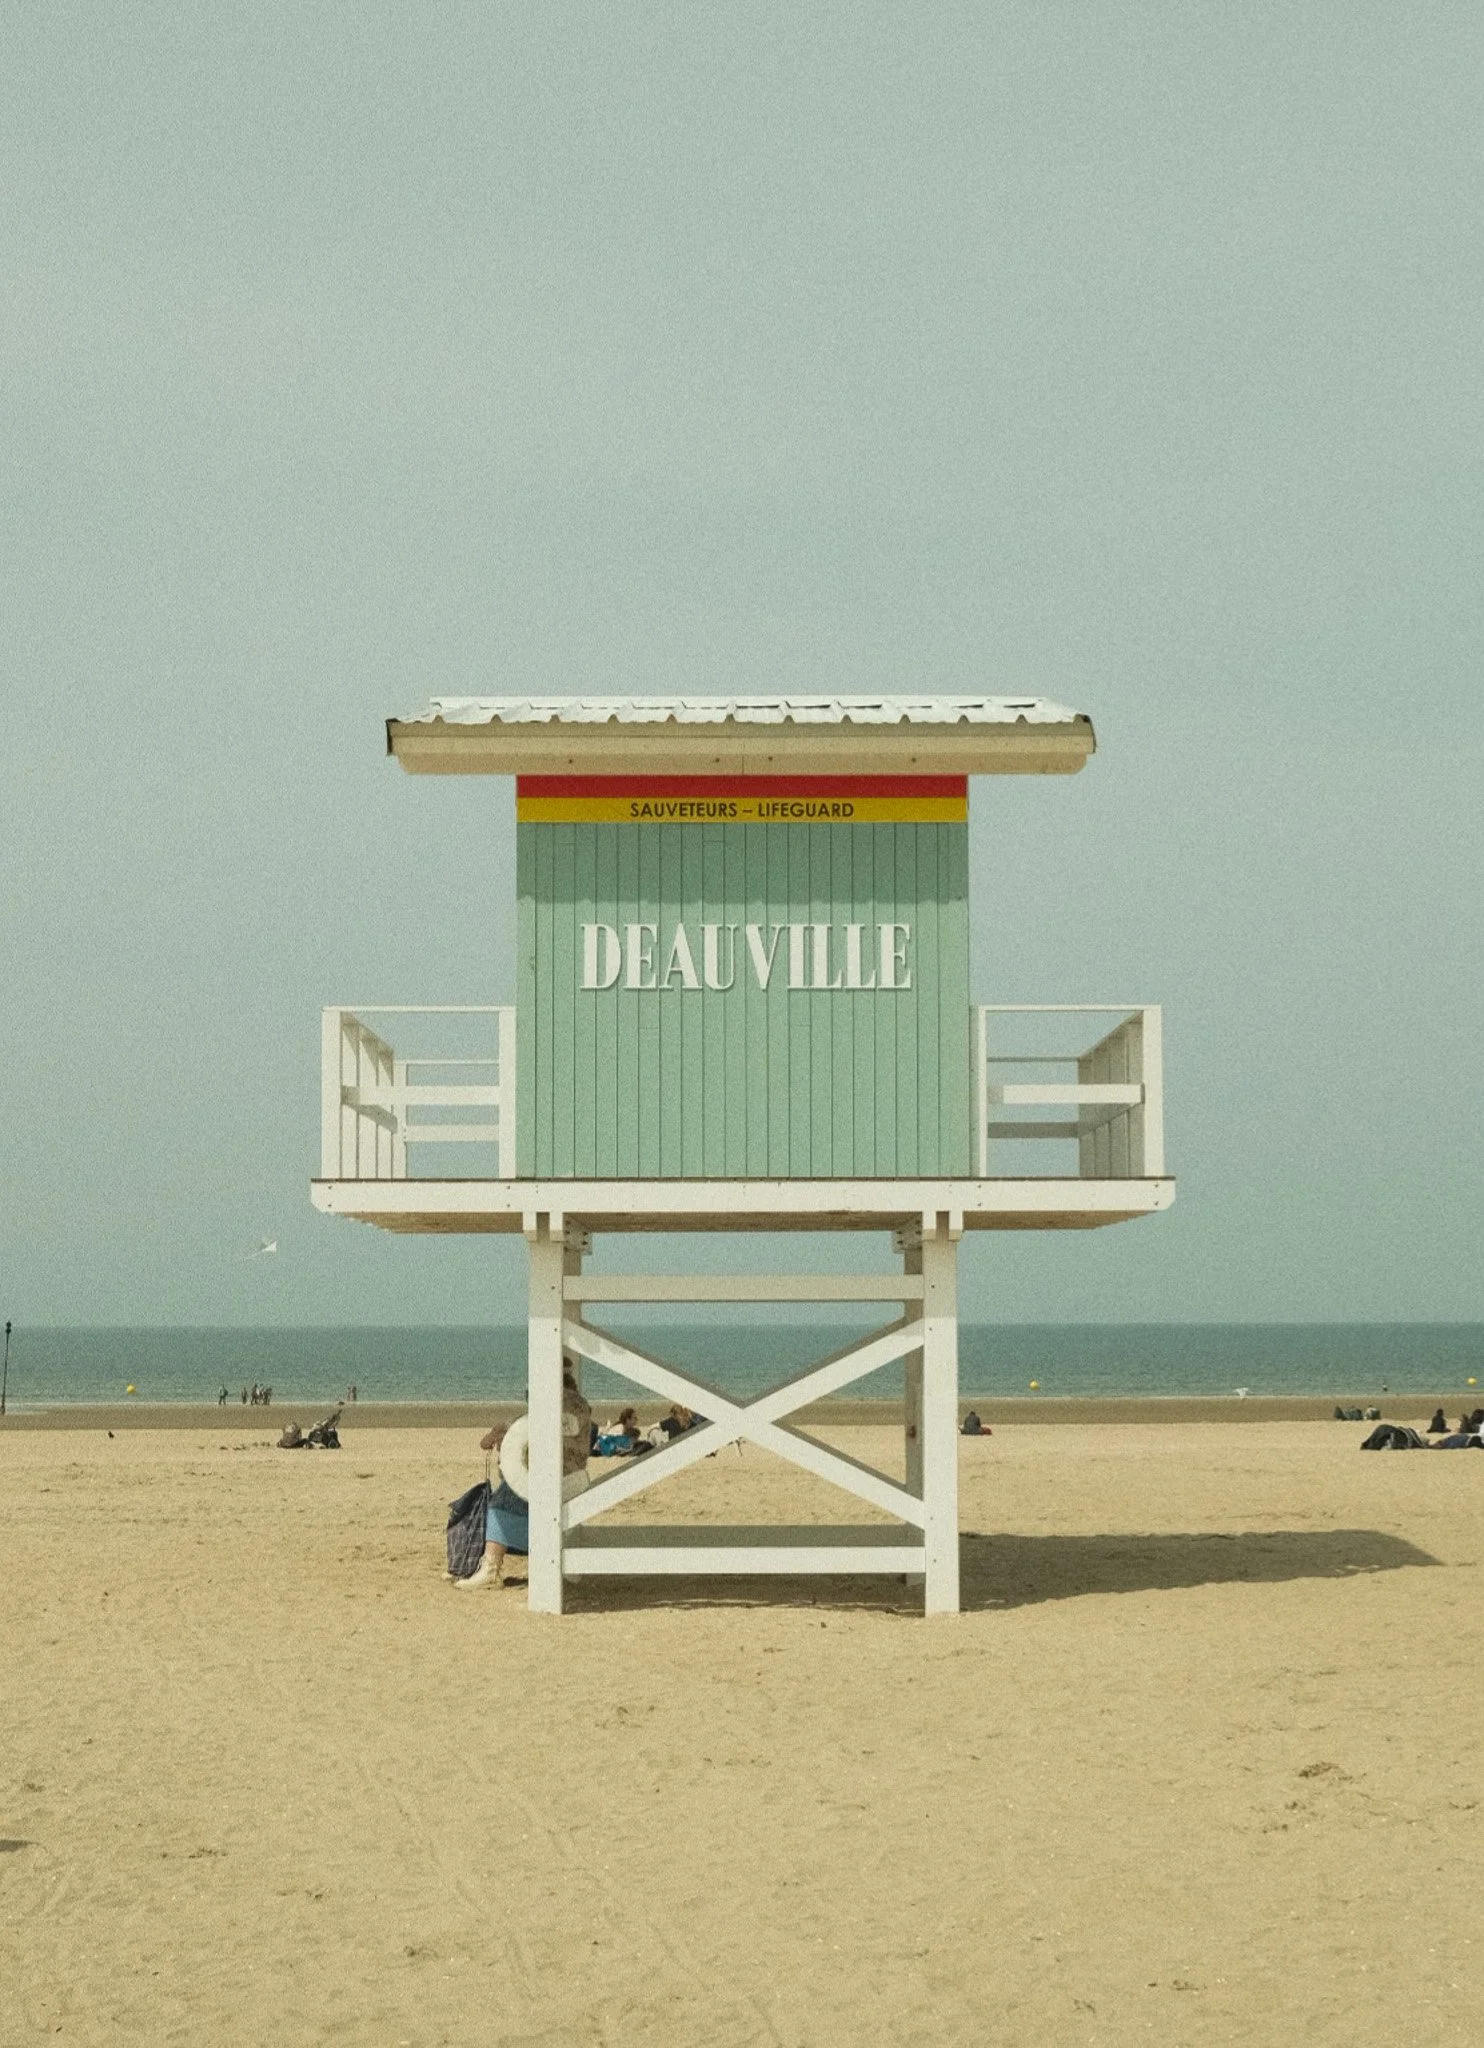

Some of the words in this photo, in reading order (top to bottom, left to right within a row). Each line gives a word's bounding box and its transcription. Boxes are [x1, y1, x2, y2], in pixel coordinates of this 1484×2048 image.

[630, 802, 738, 818] SAUVETEURS
[757, 802, 855, 818] LIFEGUARD
[579, 923, 912, 990] DEAUVILLE
